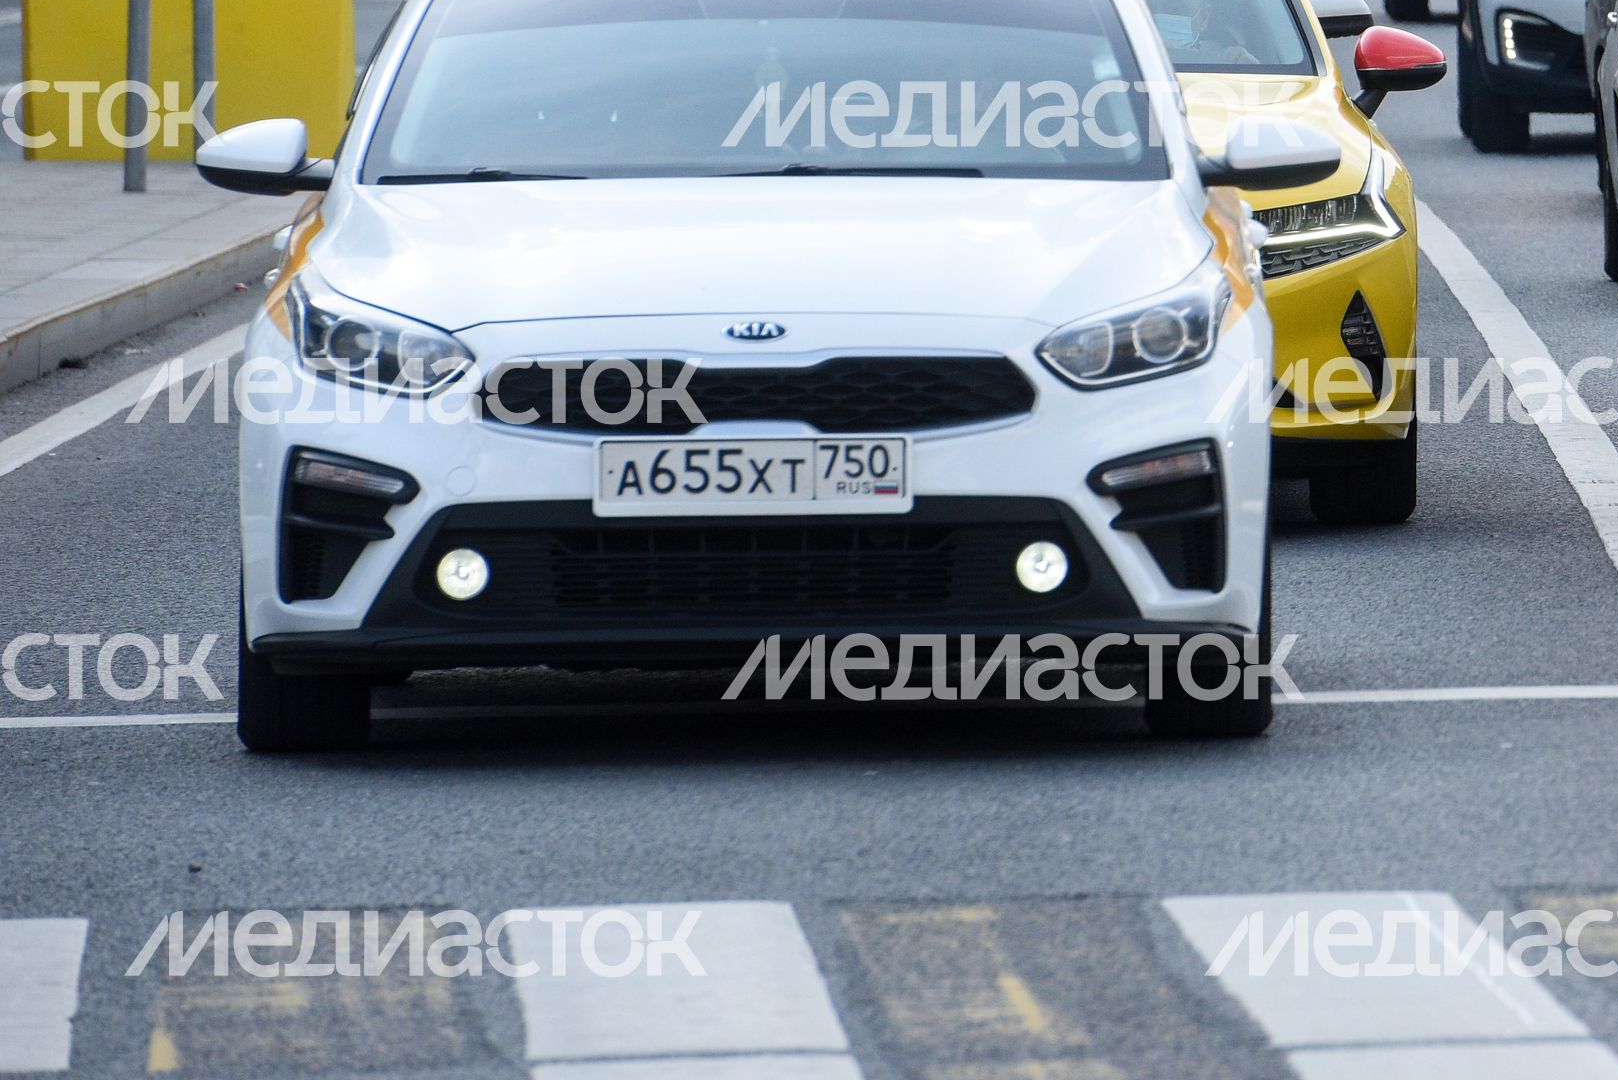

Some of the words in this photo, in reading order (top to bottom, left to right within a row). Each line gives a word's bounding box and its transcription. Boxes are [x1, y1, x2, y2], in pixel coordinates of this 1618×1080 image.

[732, 322, 779, 337] KIA
[818, 444, 891, 480] 750
[835, 481, 872, 495] RUS
